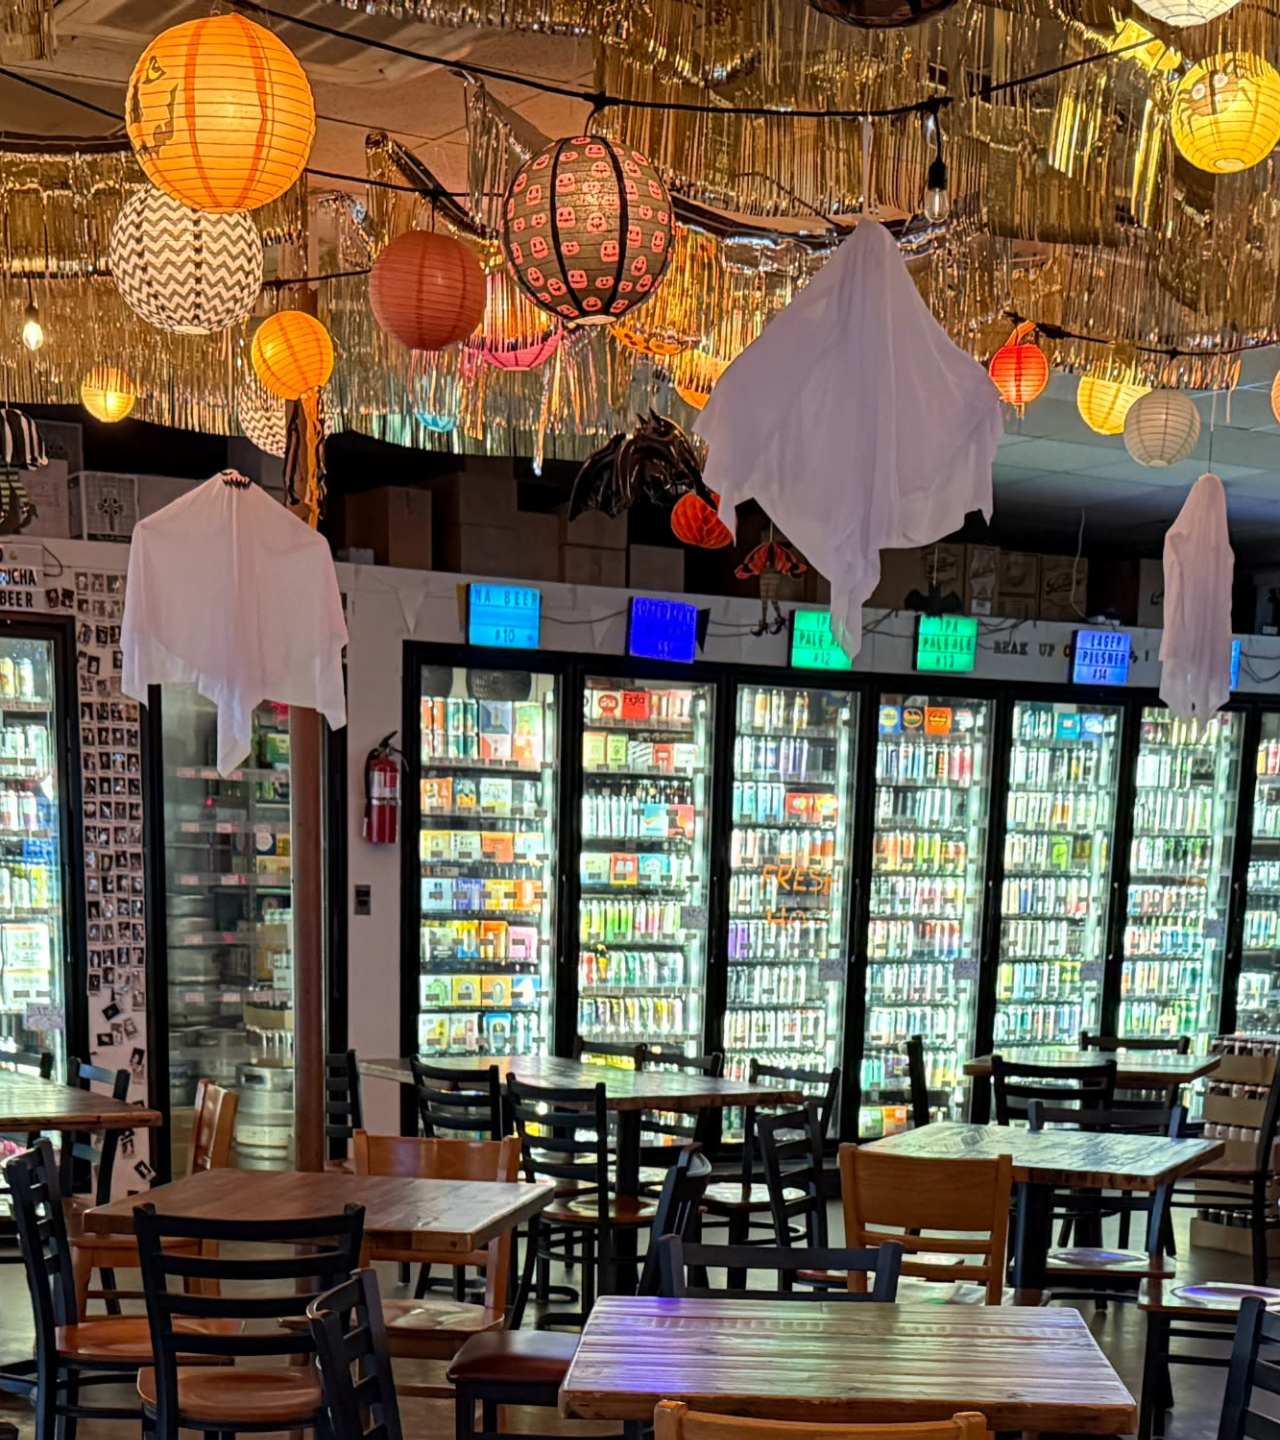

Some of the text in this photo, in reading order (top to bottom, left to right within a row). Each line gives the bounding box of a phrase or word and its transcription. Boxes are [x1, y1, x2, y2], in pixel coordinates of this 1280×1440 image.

[0, 590, 34, 608] BEER
[1091, 634, 1122, 649] LAGER
[1082, 650, 1126, 666] PILSNER
